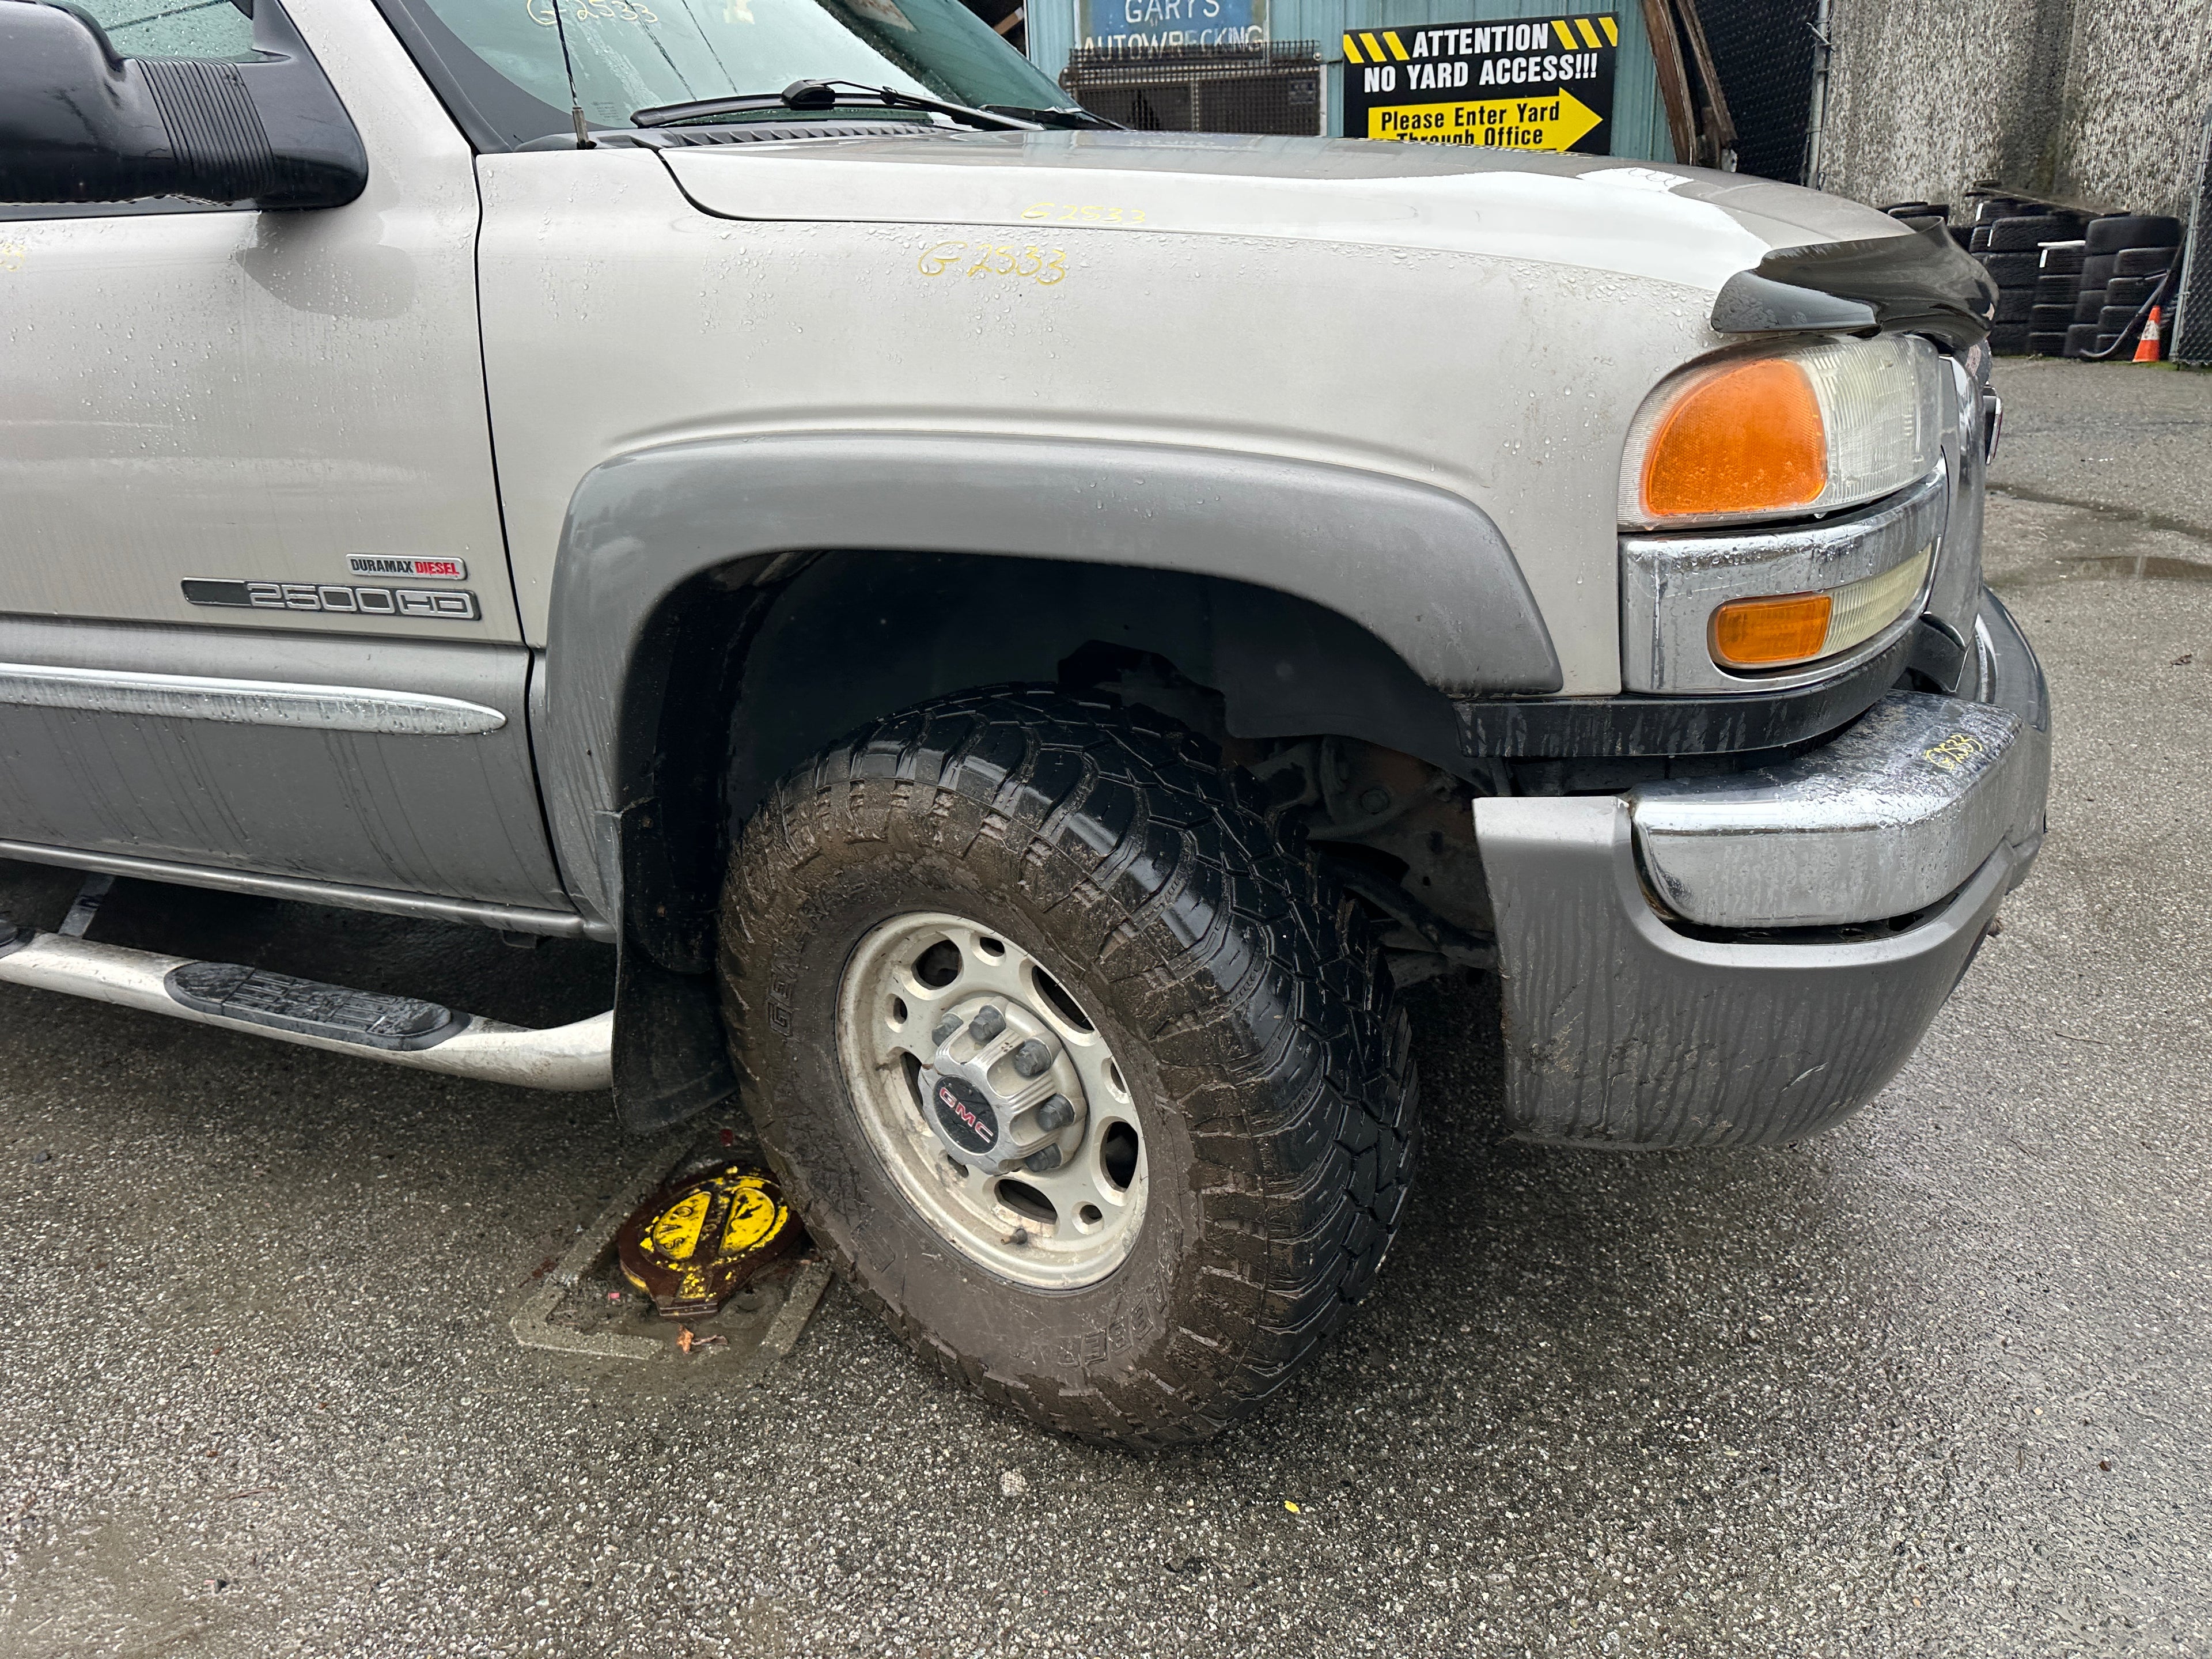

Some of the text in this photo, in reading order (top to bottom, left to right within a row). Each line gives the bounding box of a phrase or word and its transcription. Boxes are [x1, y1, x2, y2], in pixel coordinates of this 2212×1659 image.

[1412, 23, 1549, 58] ATTENTION
[1364, 52, 1598, 93] NO YARD ACCESS!!!
[1381, 101, 1560, 131] Please Enter Yard
[1484, 126, 1543, 146] Office
[350, 558, 460, 575] DURAMAX DIESEL
[940, 1087, 994, 1143] GMC
